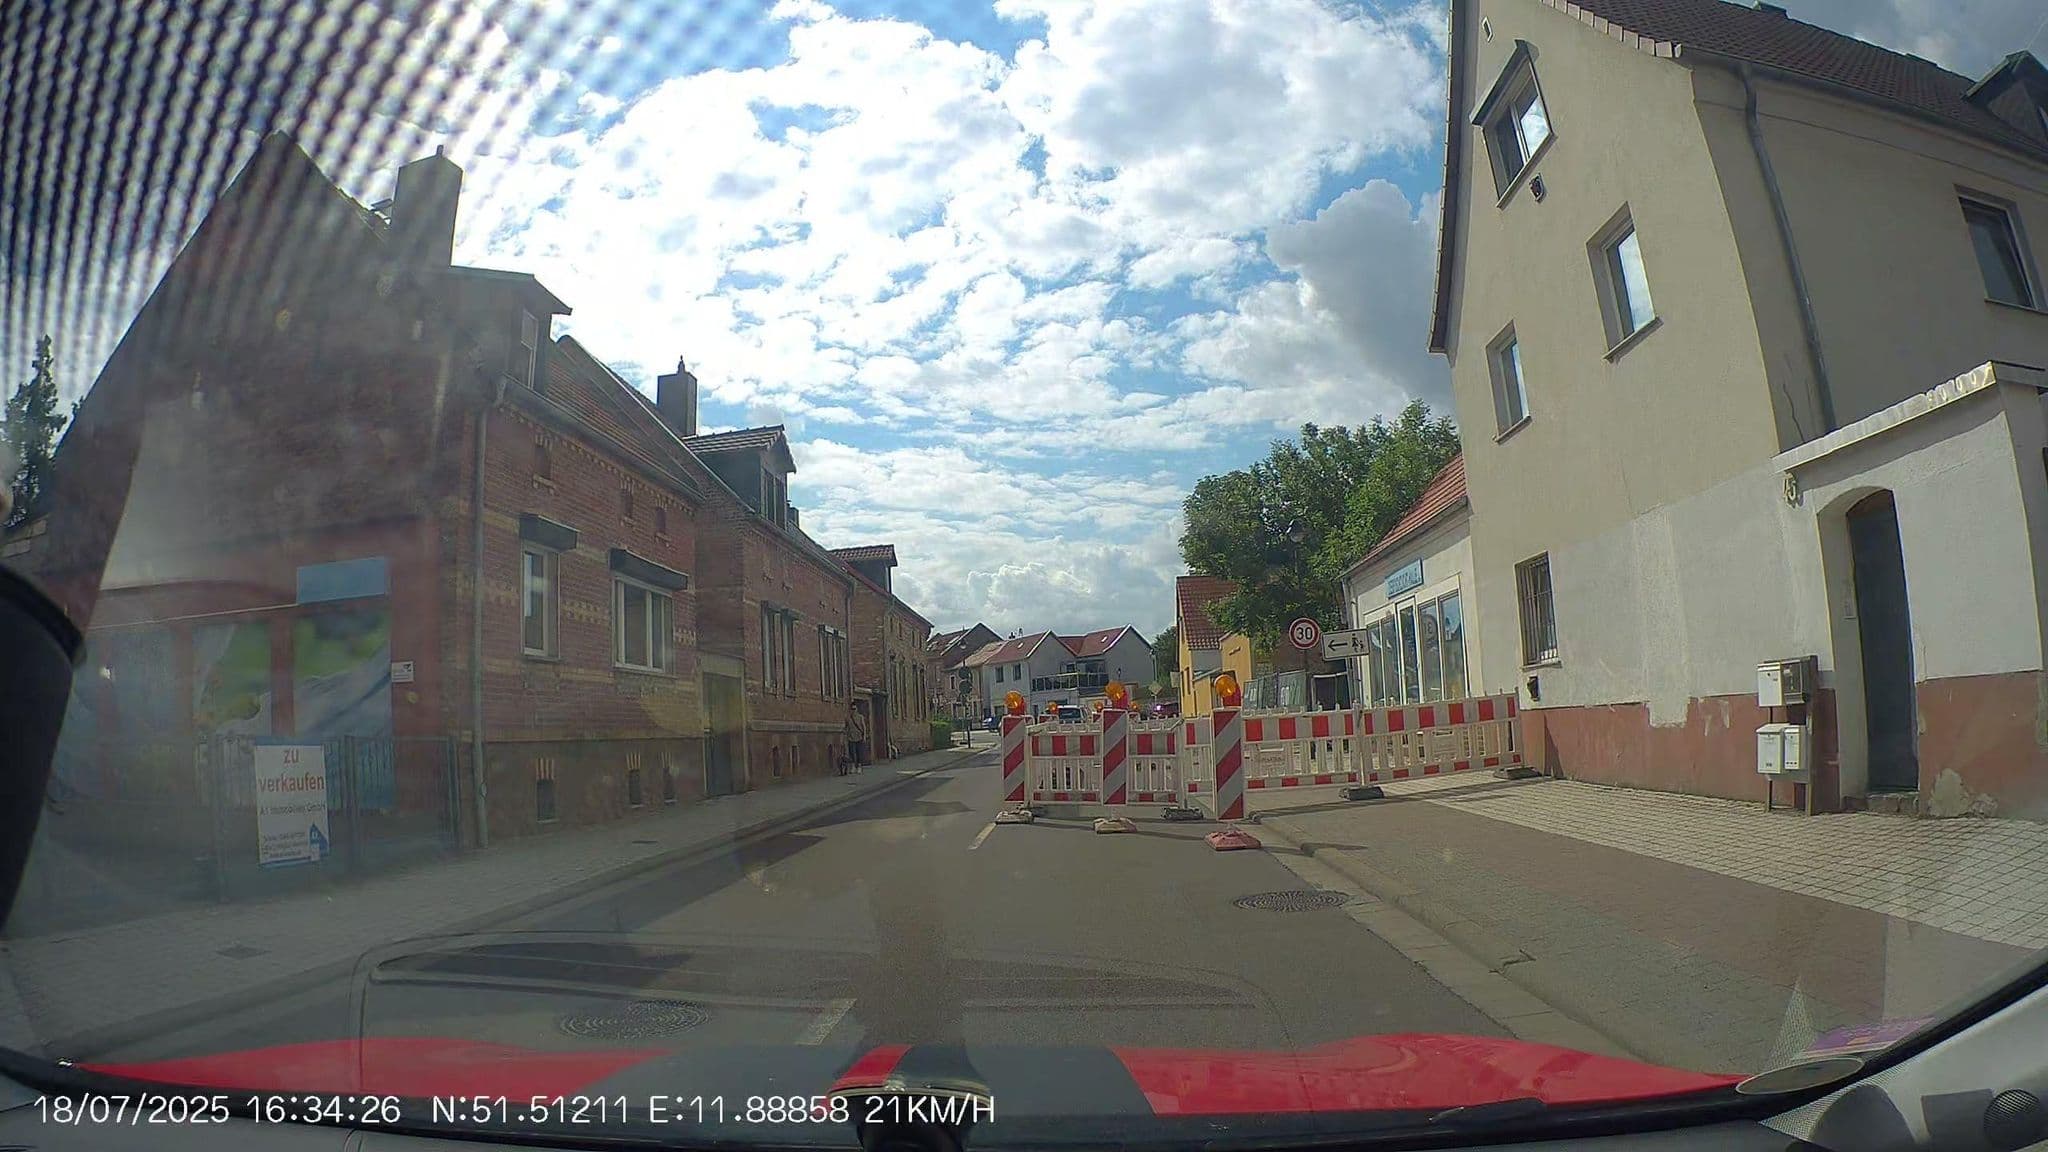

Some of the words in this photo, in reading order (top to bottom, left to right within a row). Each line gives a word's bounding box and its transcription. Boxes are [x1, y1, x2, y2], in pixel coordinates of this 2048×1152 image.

[1296, 627, 1312, 640] 30
[283, 749, 299, 764] zu
[258, 772, 325, 792] verkaufen
